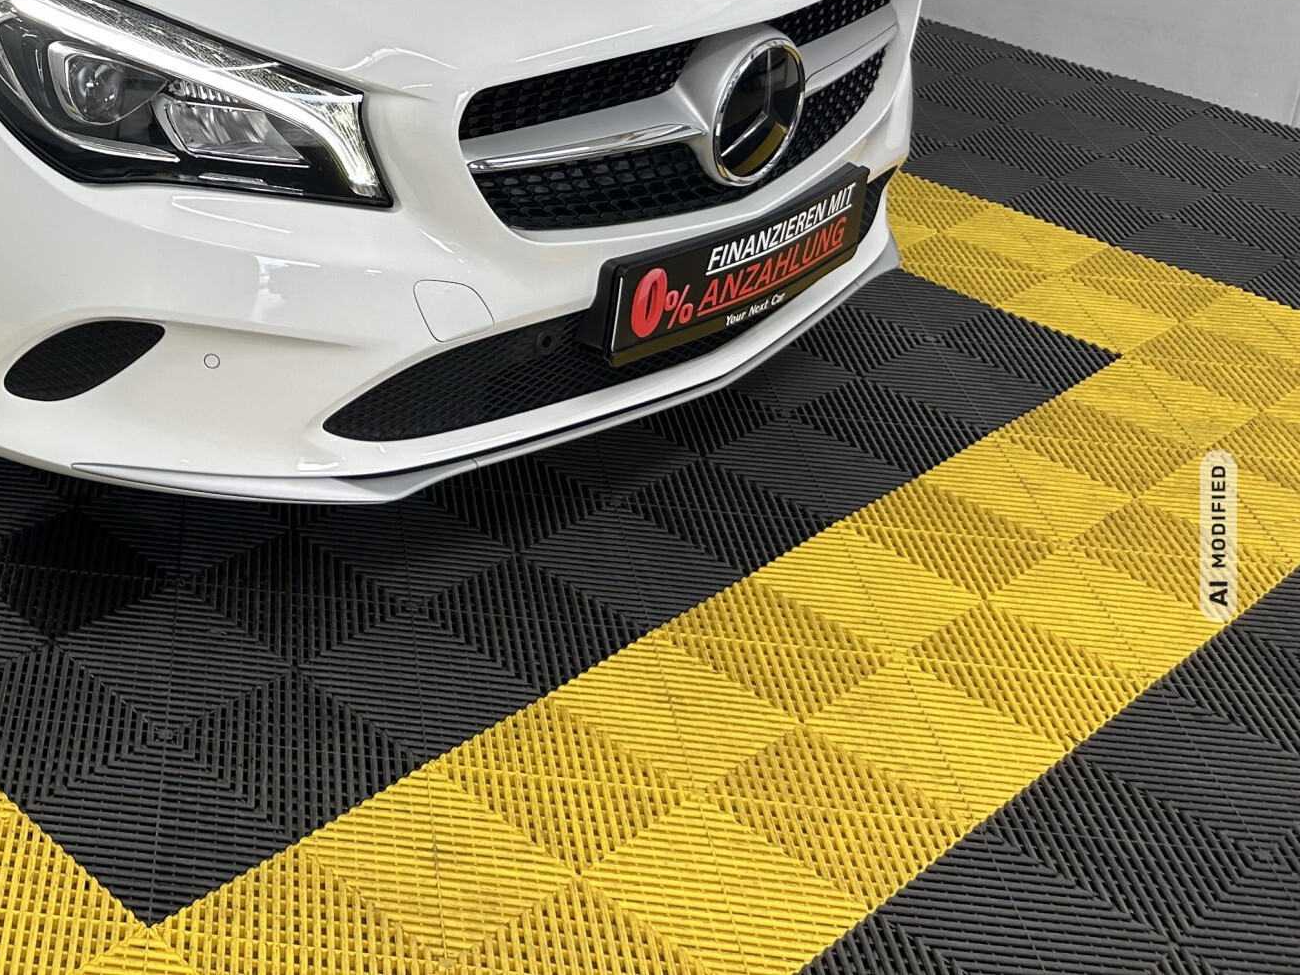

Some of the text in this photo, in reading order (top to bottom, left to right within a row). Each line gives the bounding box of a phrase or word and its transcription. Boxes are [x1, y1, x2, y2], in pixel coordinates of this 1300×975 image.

[706, 181, 856, 272] FINANZIEREN MIT
[630, 215, 848, 339] 0% ANZAHLUNG
[725, 292, 786, 326] Your Next Car
